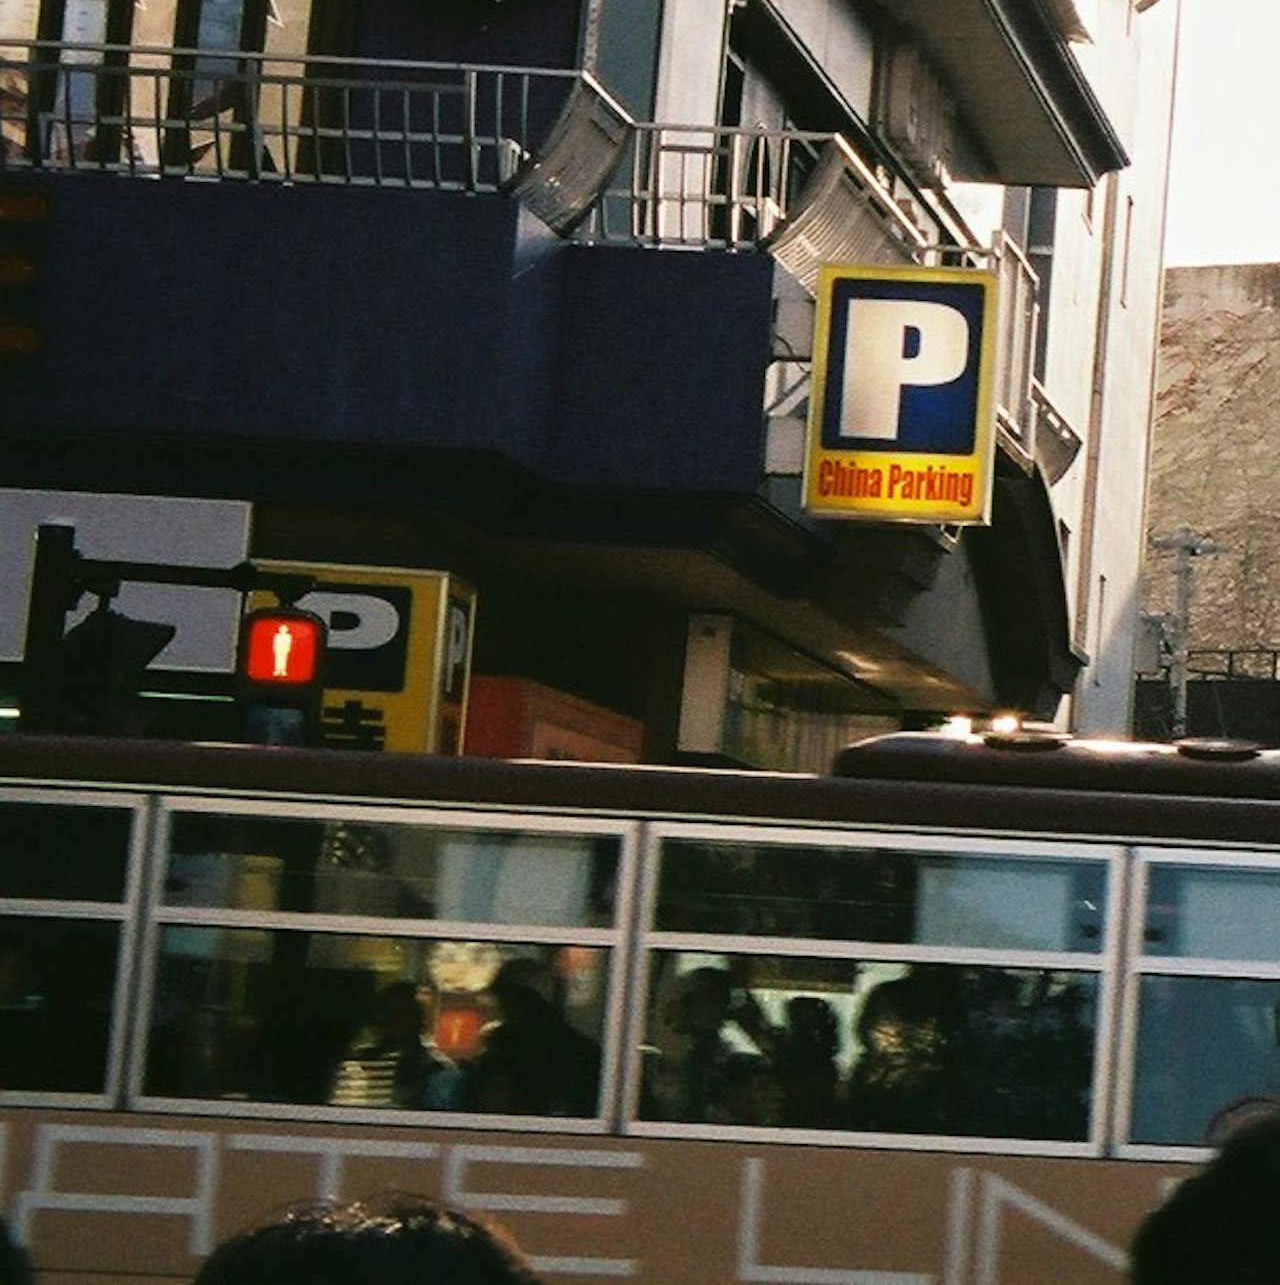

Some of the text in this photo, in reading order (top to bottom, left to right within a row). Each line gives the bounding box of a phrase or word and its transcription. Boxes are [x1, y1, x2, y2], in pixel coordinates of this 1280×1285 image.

[838, 298, 970, 441] P
[818, 458, 975, 507] China Parking
